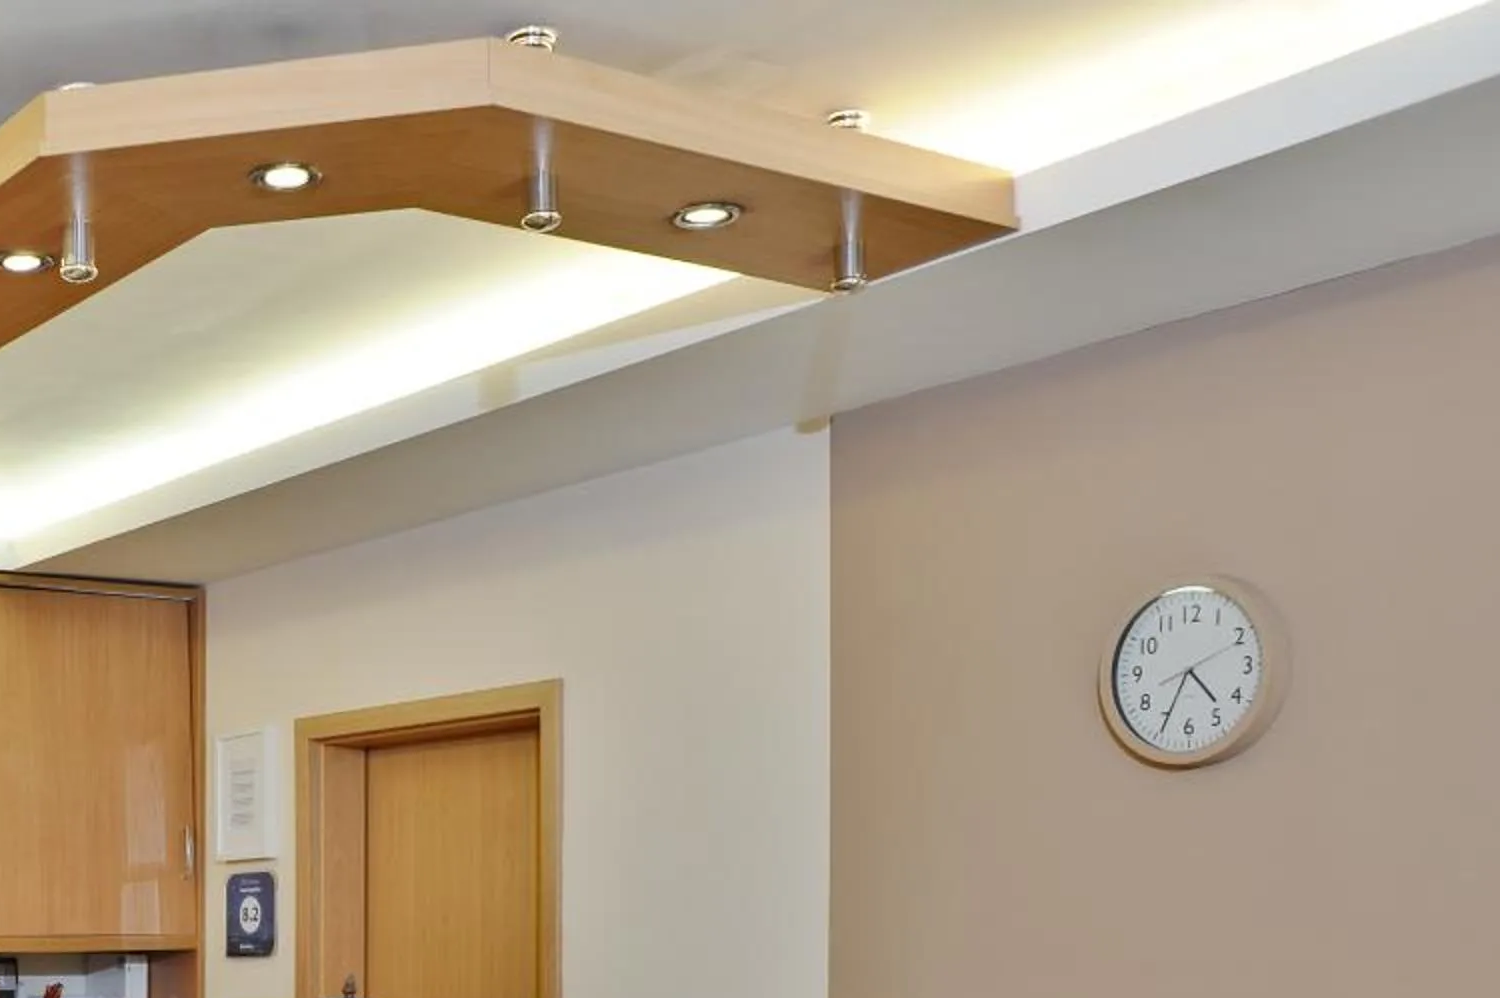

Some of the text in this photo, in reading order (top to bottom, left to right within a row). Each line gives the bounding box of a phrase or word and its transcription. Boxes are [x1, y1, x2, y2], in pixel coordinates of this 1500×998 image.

[1182, 604, 1202, 625] 12
[1215, 607, 1221, 626] 1
[1159, 615, 1173, 633] 11
[1234, 627, 1245, 645] 2
[1141, 637, 1158, 655] 10
[1132, 665, 1143, 683] 9
[1243, 655, 1253, 675] 3
[1139, 693, 1151, 711] 8
[1231, 687, 1242, 704] 4
[1183, 717, 1195, 735] 6
[1211, 708, 1221, 727] 5
[242, 907, 259, 922] 8.2
